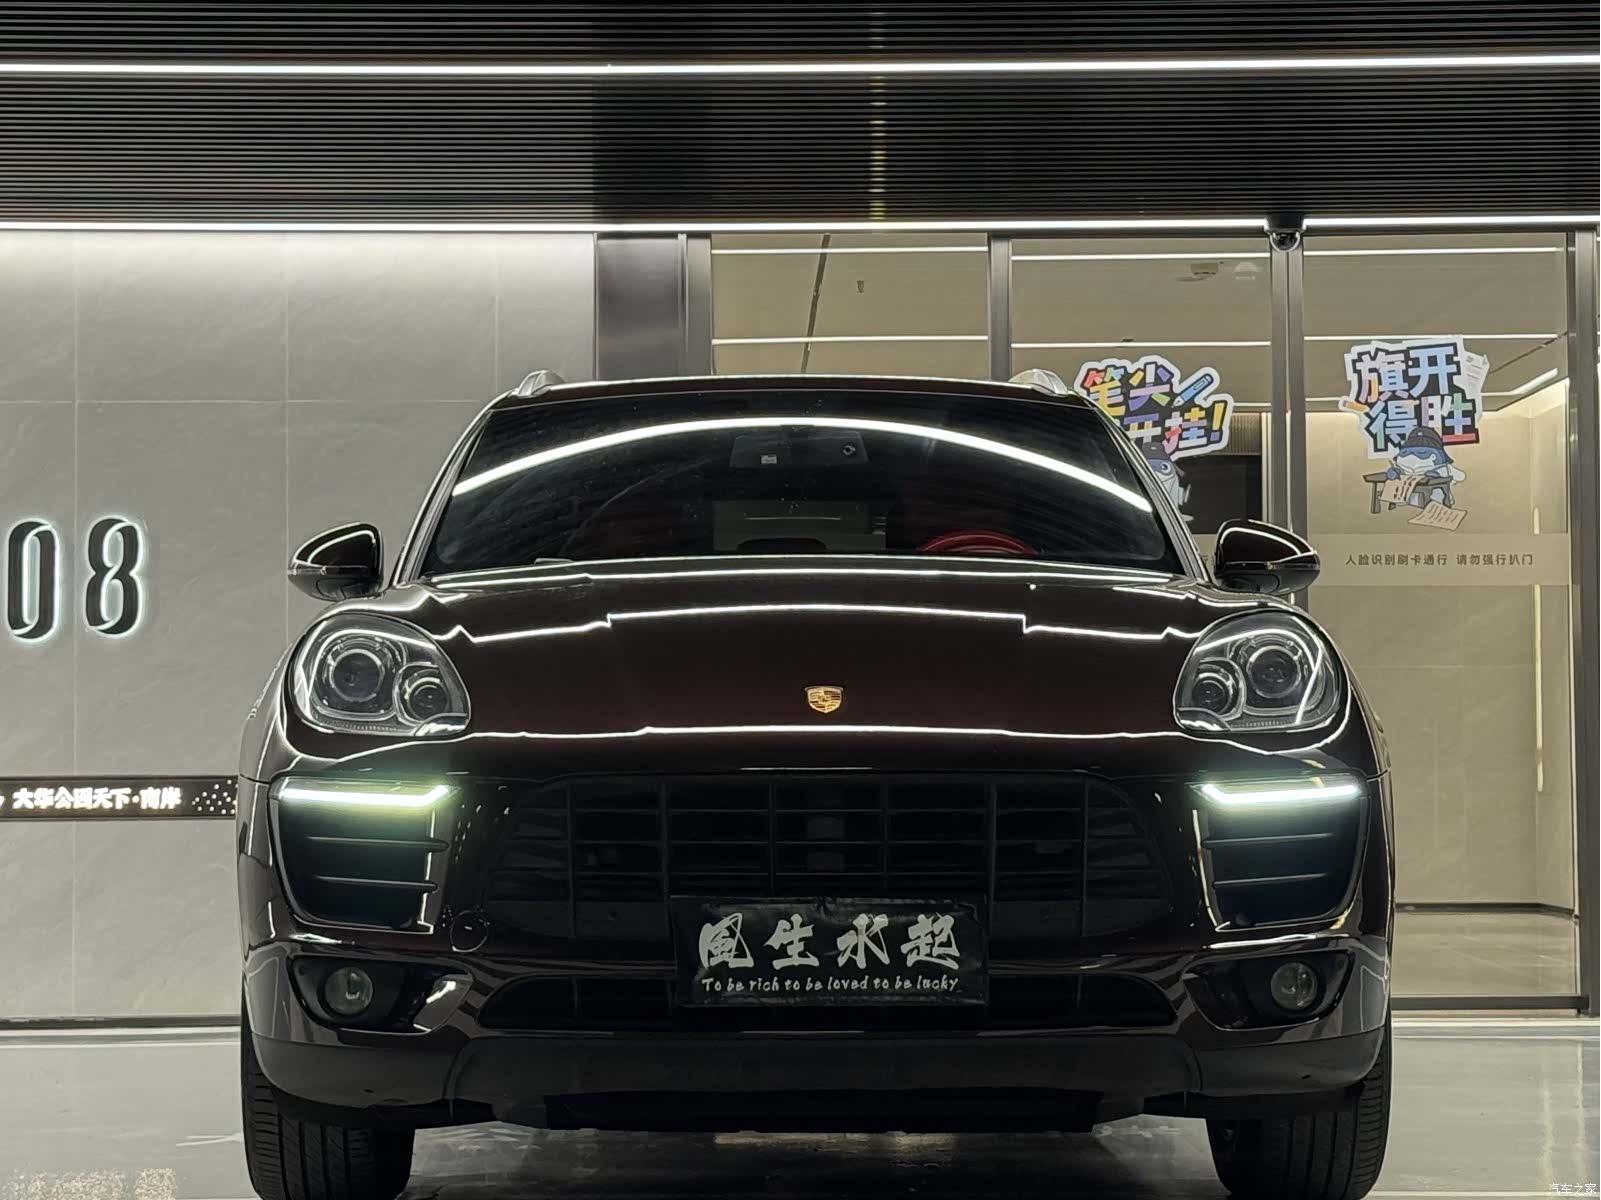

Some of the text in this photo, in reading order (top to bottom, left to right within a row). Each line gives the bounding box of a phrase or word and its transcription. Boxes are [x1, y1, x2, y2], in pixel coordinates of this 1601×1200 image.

[1083, 364, 1171, 416] 笔尖
[1355, 346, 1458, 403] 旗开
[1368, 393, 1476, 449] 得胜
[7, 517, 141, 639] 08
[1345, 553, 1534, 566] 人脸识别刷卡通行 请勿强行扒门
[702, 974, 959, 992] To be rich to be loved to be lucky
